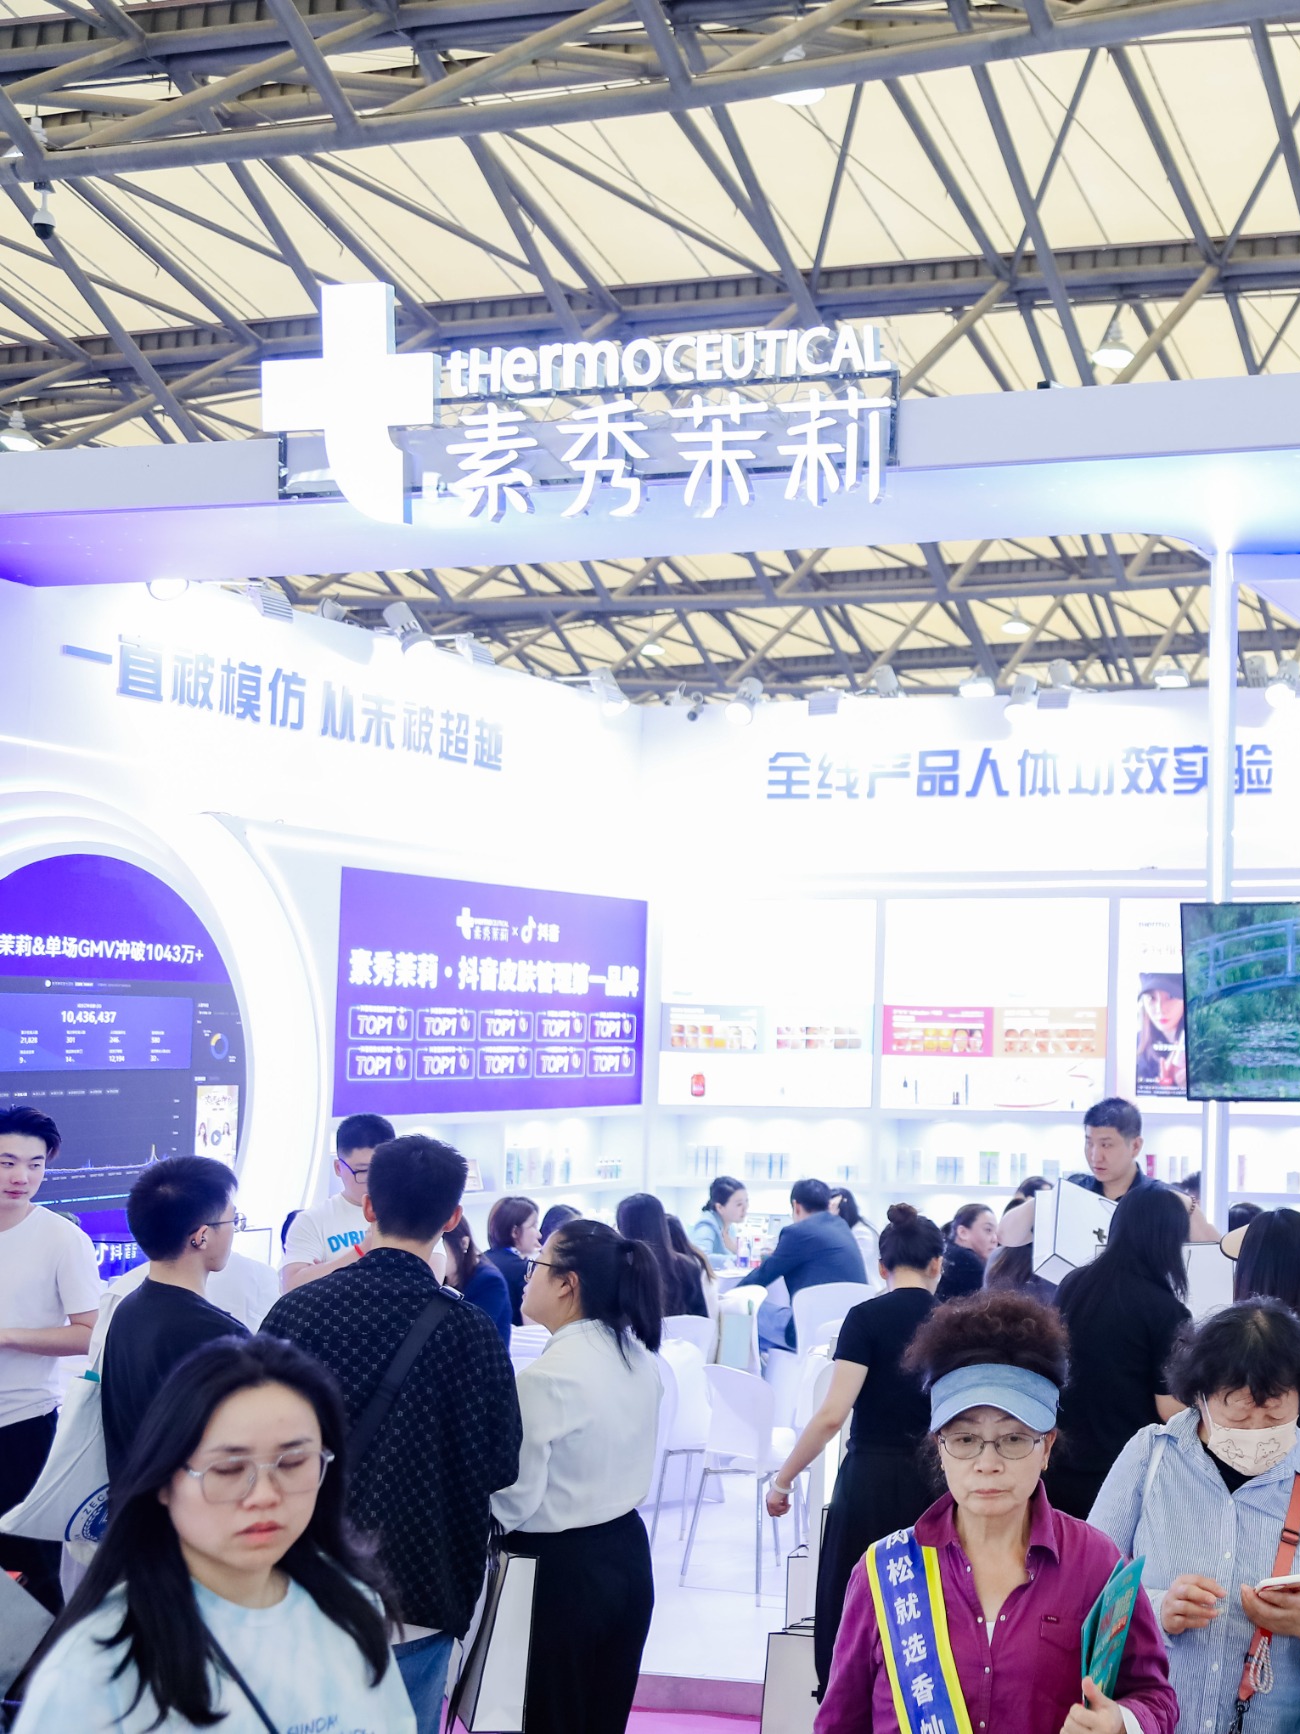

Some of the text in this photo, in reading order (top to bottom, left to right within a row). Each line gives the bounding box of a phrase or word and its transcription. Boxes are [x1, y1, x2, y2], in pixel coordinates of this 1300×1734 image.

[446, 387, 892, 522] 素秀茉莉
[62, 634, 504, 771] 一直被模仿 从未被超越
[537, 923, 560, 943] 抖音
[61, 1010, 117, 1025] 10,436,437
[357, 1015, 393, 1035] TOP1
[424, 1017, 457, 1036] TOP1
[485, 1018, 516, 1037] TOP1
[542, 1019, 570, 1037] TOP1
[594, 1020, 621, 1038] TOP1
[355, 1056, 391, 1075] TOP1
[422, 1056, 456, 1075] TOP1
[484, 1055, 515, 1074] TOP1
[541, 1055, 569, 1073] TOP1
[593, 1055, 620, 1072] TOP1
